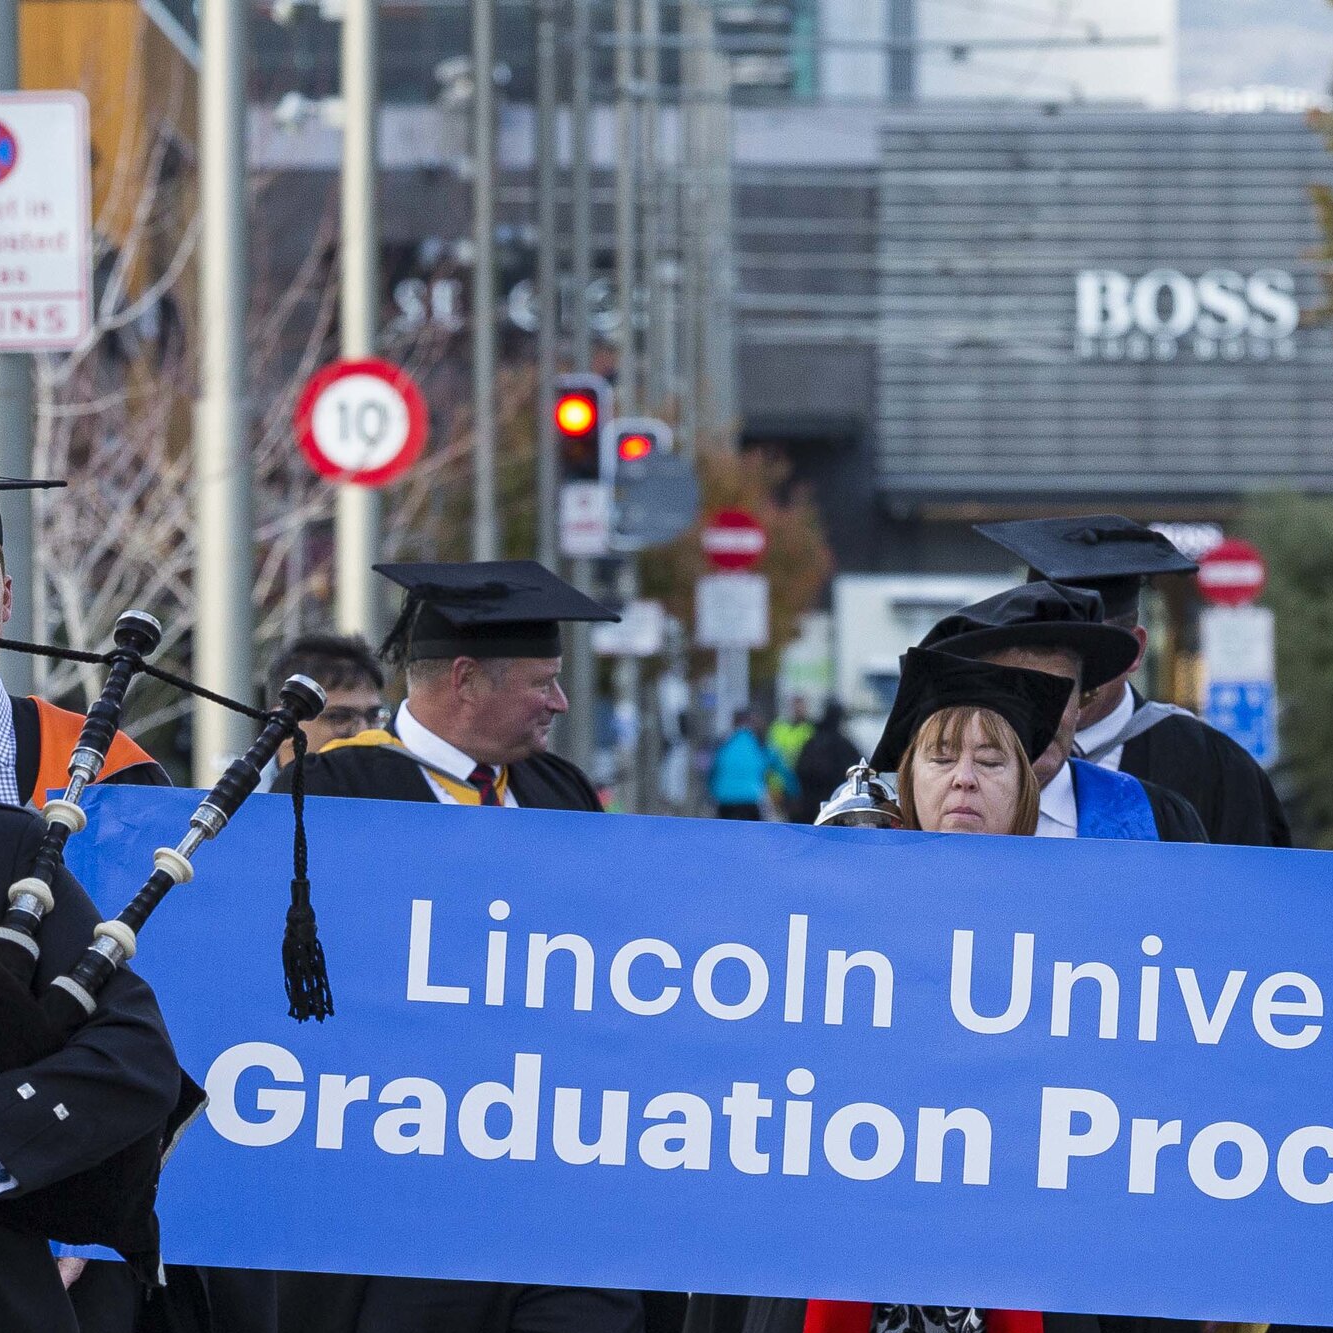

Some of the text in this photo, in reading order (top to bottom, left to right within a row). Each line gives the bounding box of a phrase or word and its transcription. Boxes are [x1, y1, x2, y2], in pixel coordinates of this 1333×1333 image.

[26, 198, 52, 219] in
[1075, 268, 1300, 340] BOSS
[338, 399, 388, 447] 10
[406, 899, 894, 1028] Lincoln
[205, 1040, 993, 1187] Graduation
